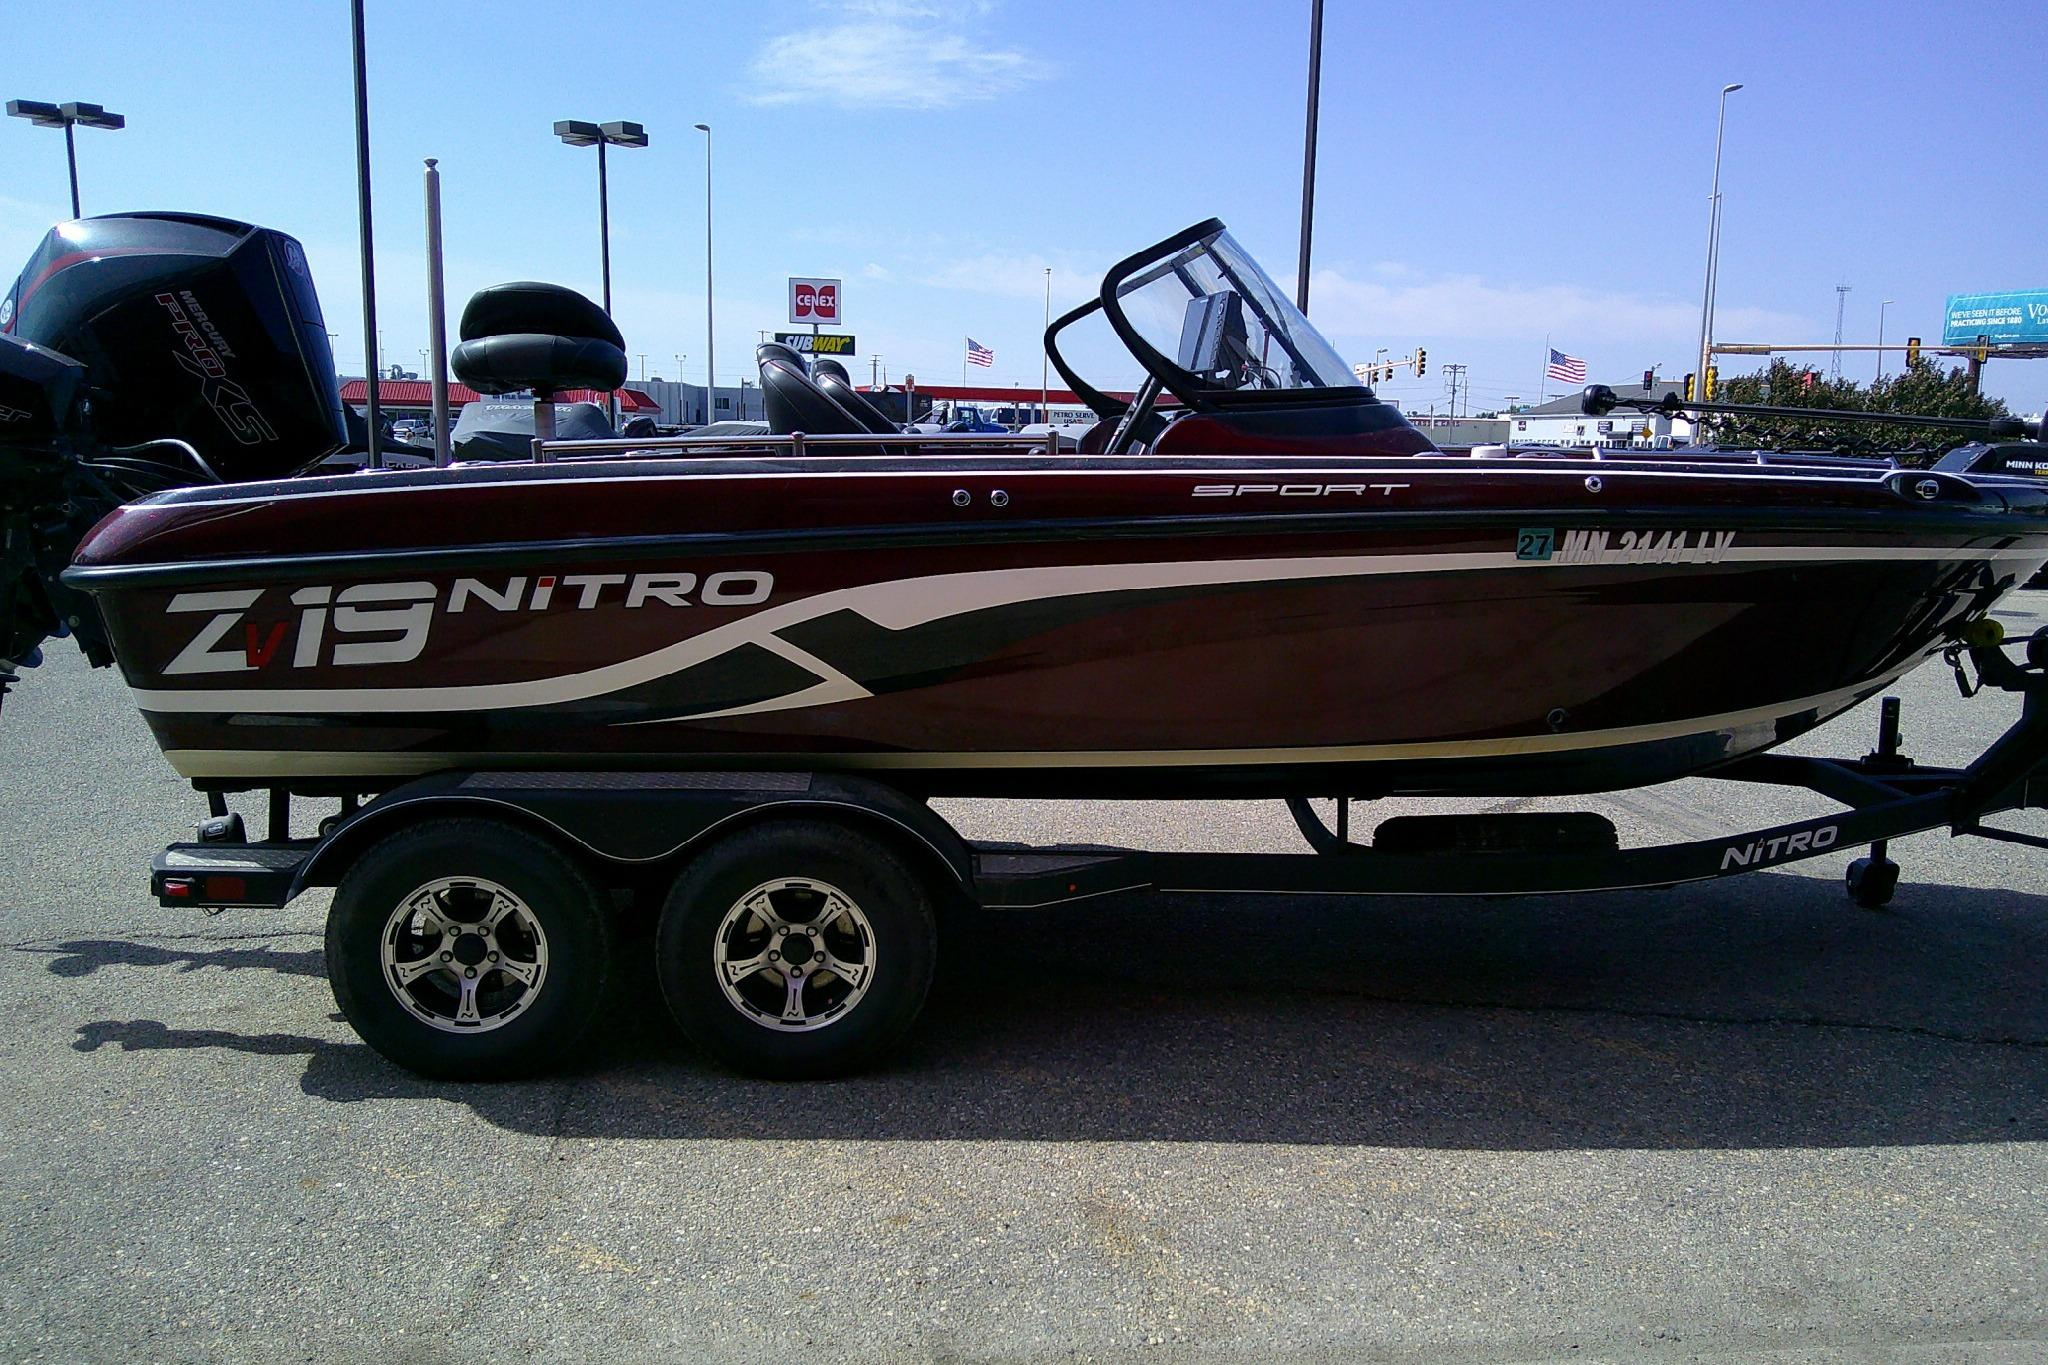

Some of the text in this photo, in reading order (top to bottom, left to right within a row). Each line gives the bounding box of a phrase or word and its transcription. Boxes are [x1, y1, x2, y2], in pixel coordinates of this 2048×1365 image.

[797, 295, 834, 307] CENEX
[1972, 309, 1988, 318] SEEN
[1989, 309, 1995, 317] IT
[2028, 304, 2048, 319] VO
[180, 290, 236, 358] MERCURY
[1950, 318, 1986, 327] PRACTICING
[1987, 317, 2006, 325] SINCE
[785, 335, 850, 352] SUBWAY
[155, 293, 279, 445] PRO XS
[2006, 460, 2033, 470] MINN
[1191, 484, 1410, 497] SPORT
[1519, 534, 1551, 556] 27
[1557, 529, 1610, 564] MN
